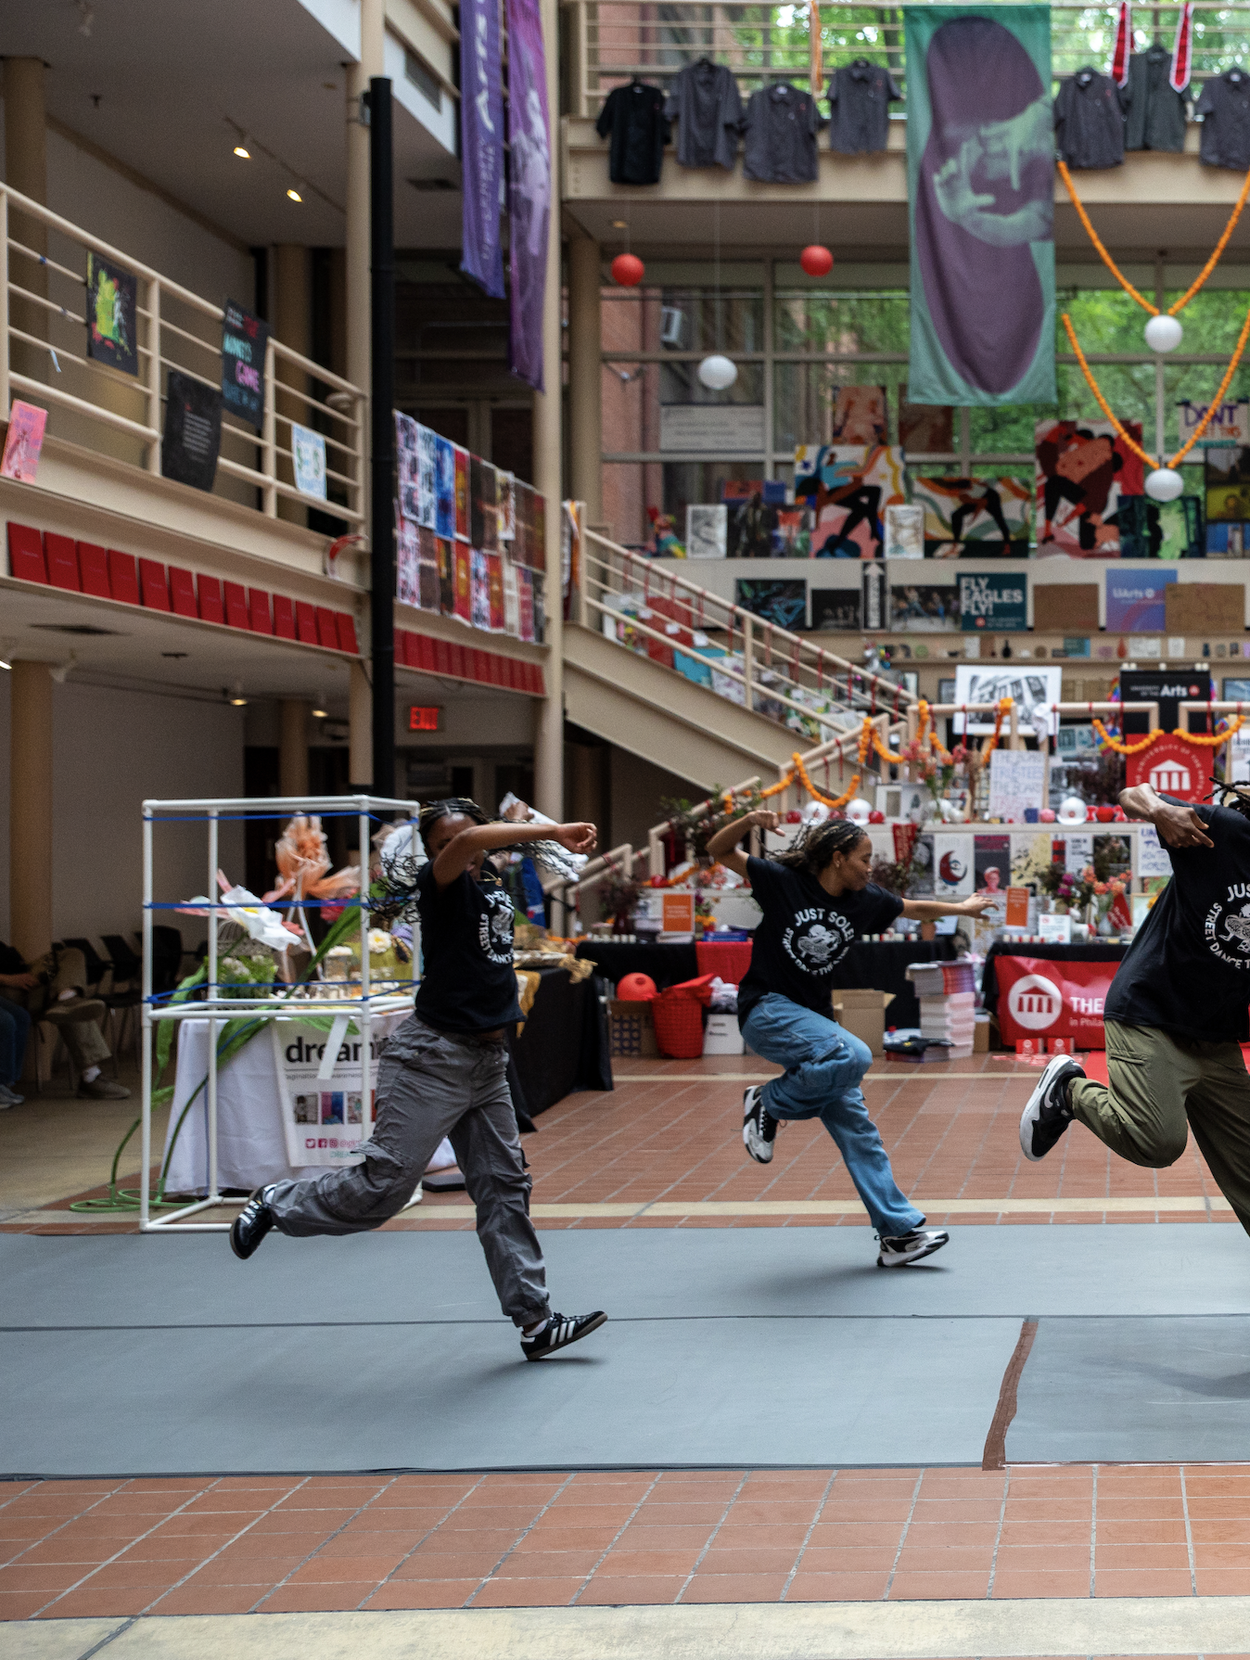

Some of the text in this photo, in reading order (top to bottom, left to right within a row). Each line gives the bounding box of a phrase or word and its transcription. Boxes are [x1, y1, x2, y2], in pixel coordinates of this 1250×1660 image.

[960, 577, 989, 591] FLY
[960, 588, 1024, 604] EAGLES
[961, 602, 994, 616] FLY!
[1160, 684, 1188, 698] Arts
[410, 706, 438, 730] EXIT
[794, 908, 825, 927] JUST
[1204, 902, 1223, 941] STREET
[479, 913, 491, 951] STREET
[1070, 996, 1104, 1014] THE
